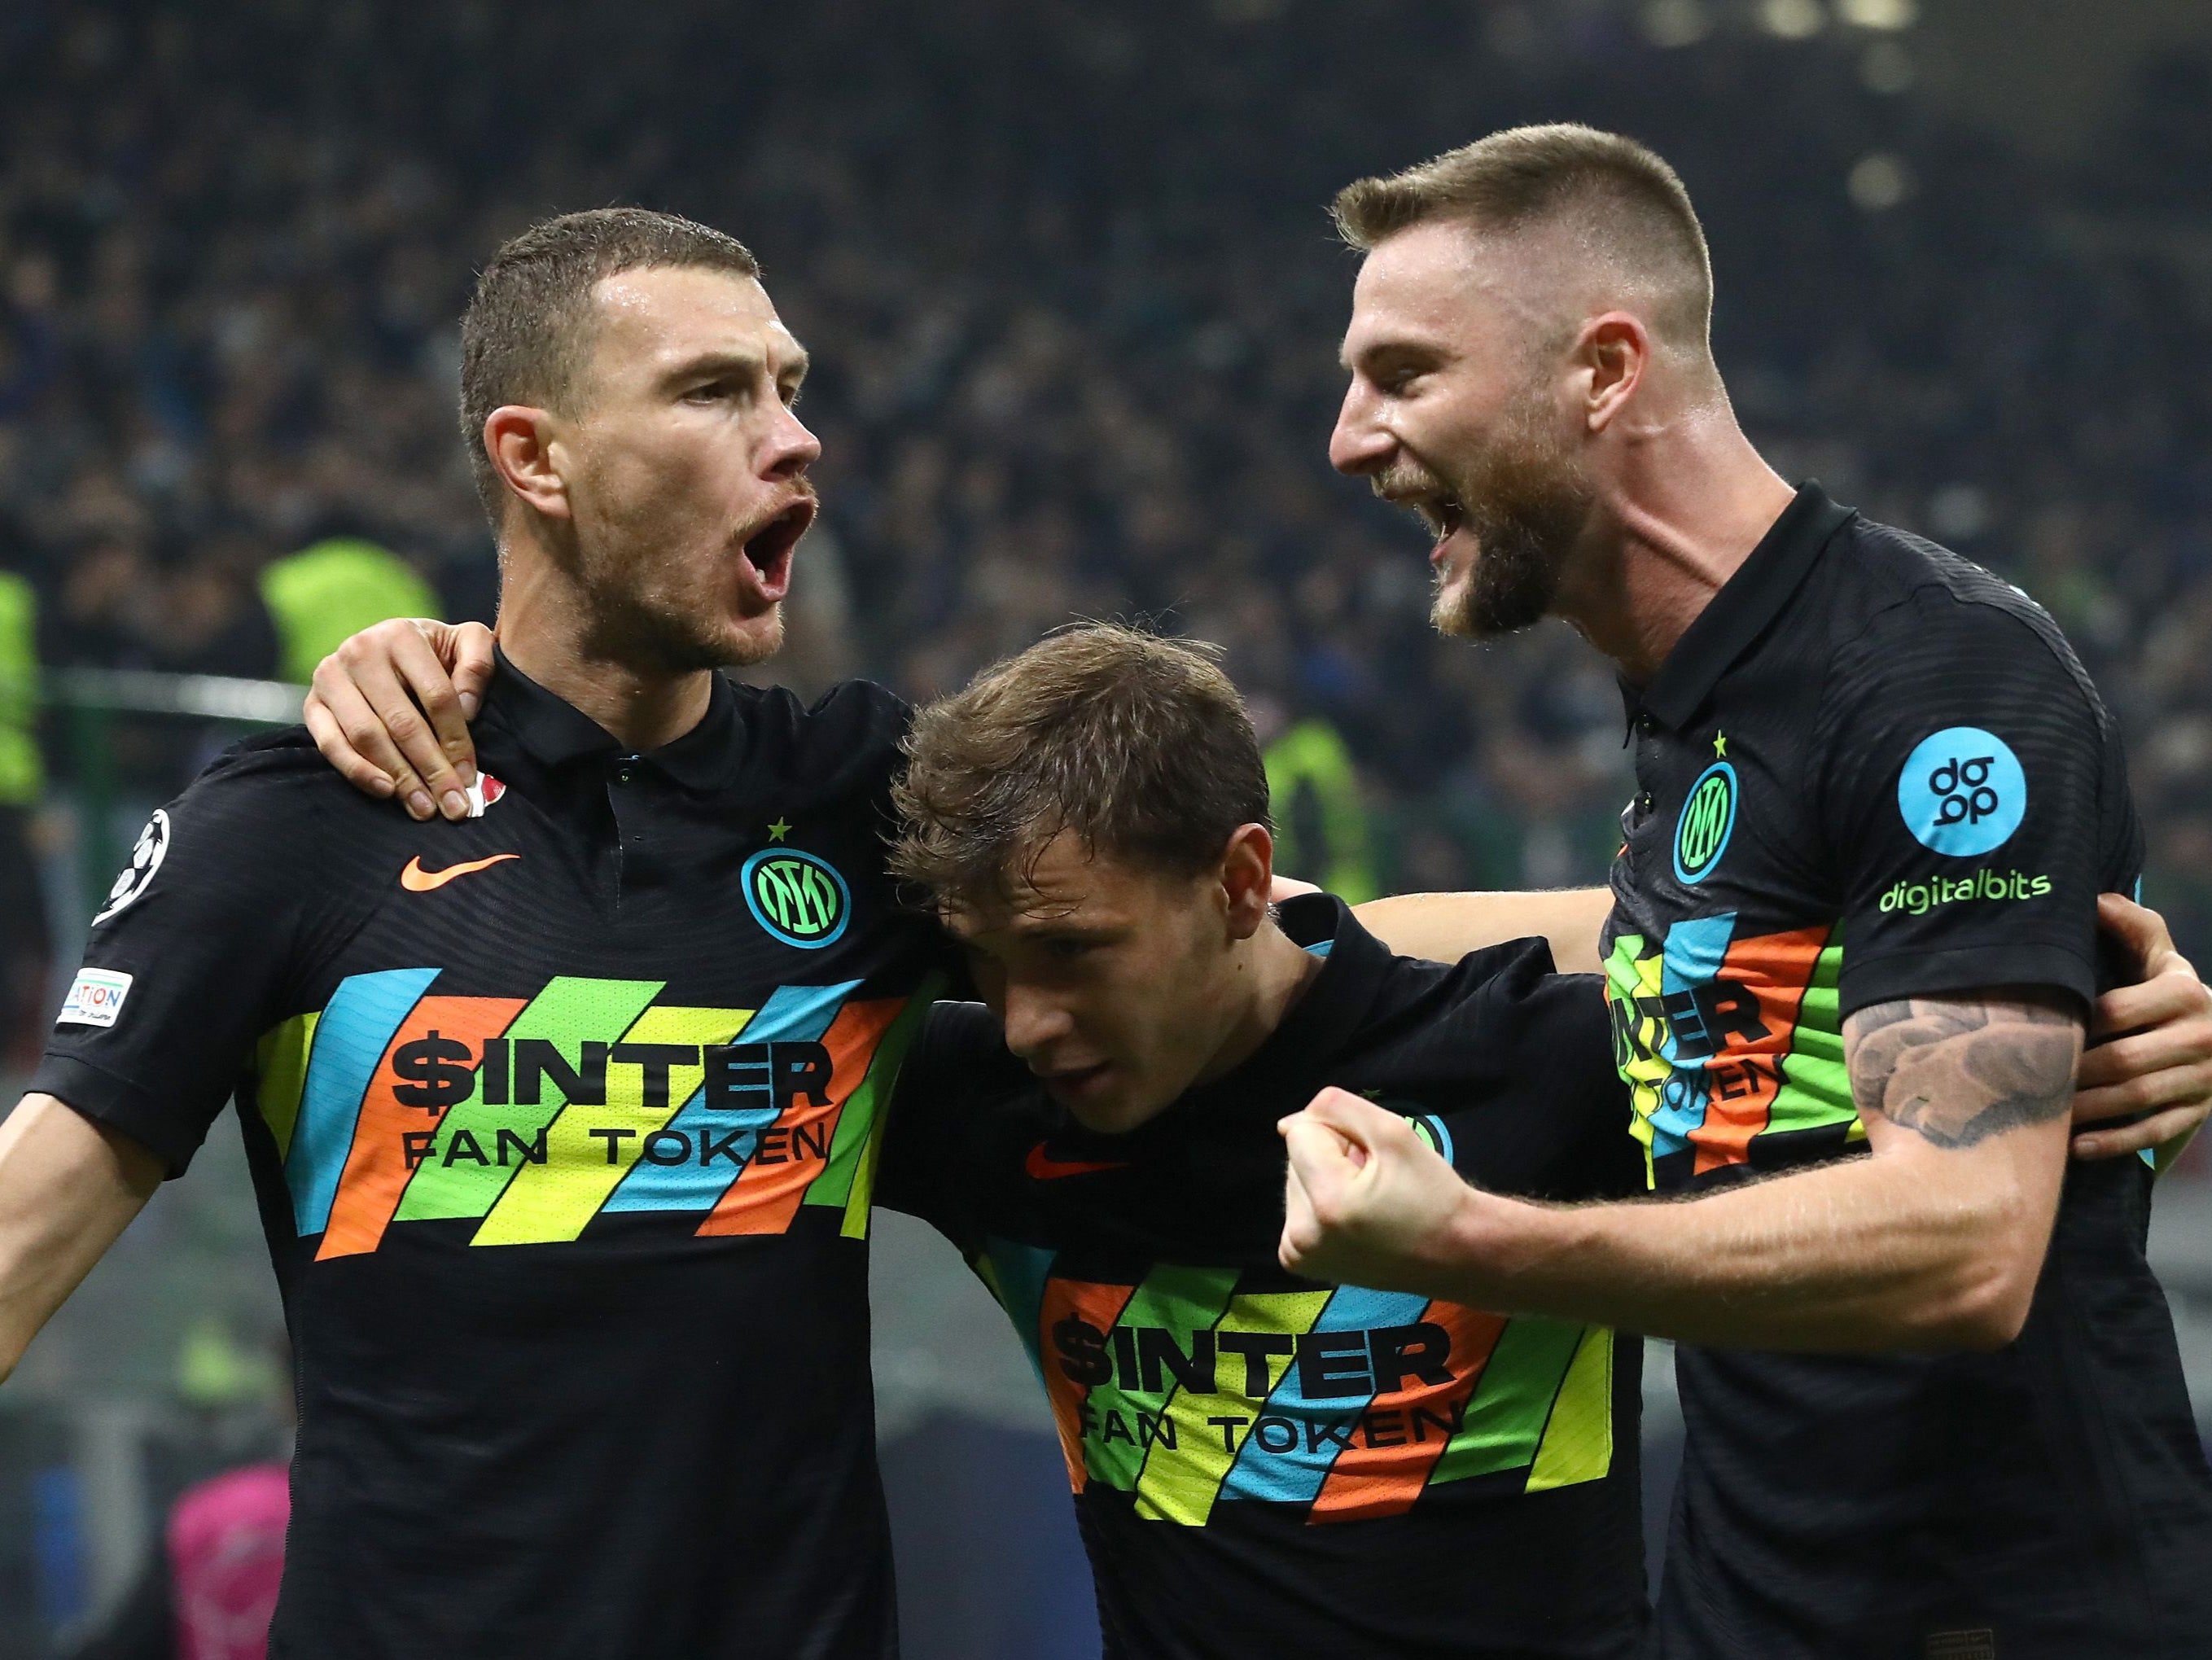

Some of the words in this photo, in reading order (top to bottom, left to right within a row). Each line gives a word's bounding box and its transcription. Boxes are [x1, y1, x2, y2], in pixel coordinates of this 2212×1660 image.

[1879, 868, 2052, 915] digitalbits
[391, 1030, 834, 1116] $INTER
[403, 1126, 548, 1169] FAN
[589, 1122, 826, 1168] TOKEN
[1052, 1312, 1457, 1403] $INTER
[1080, 1407, 1177, 1450] FAN
[1207, 1400, 1465, 1456] TOKEN
